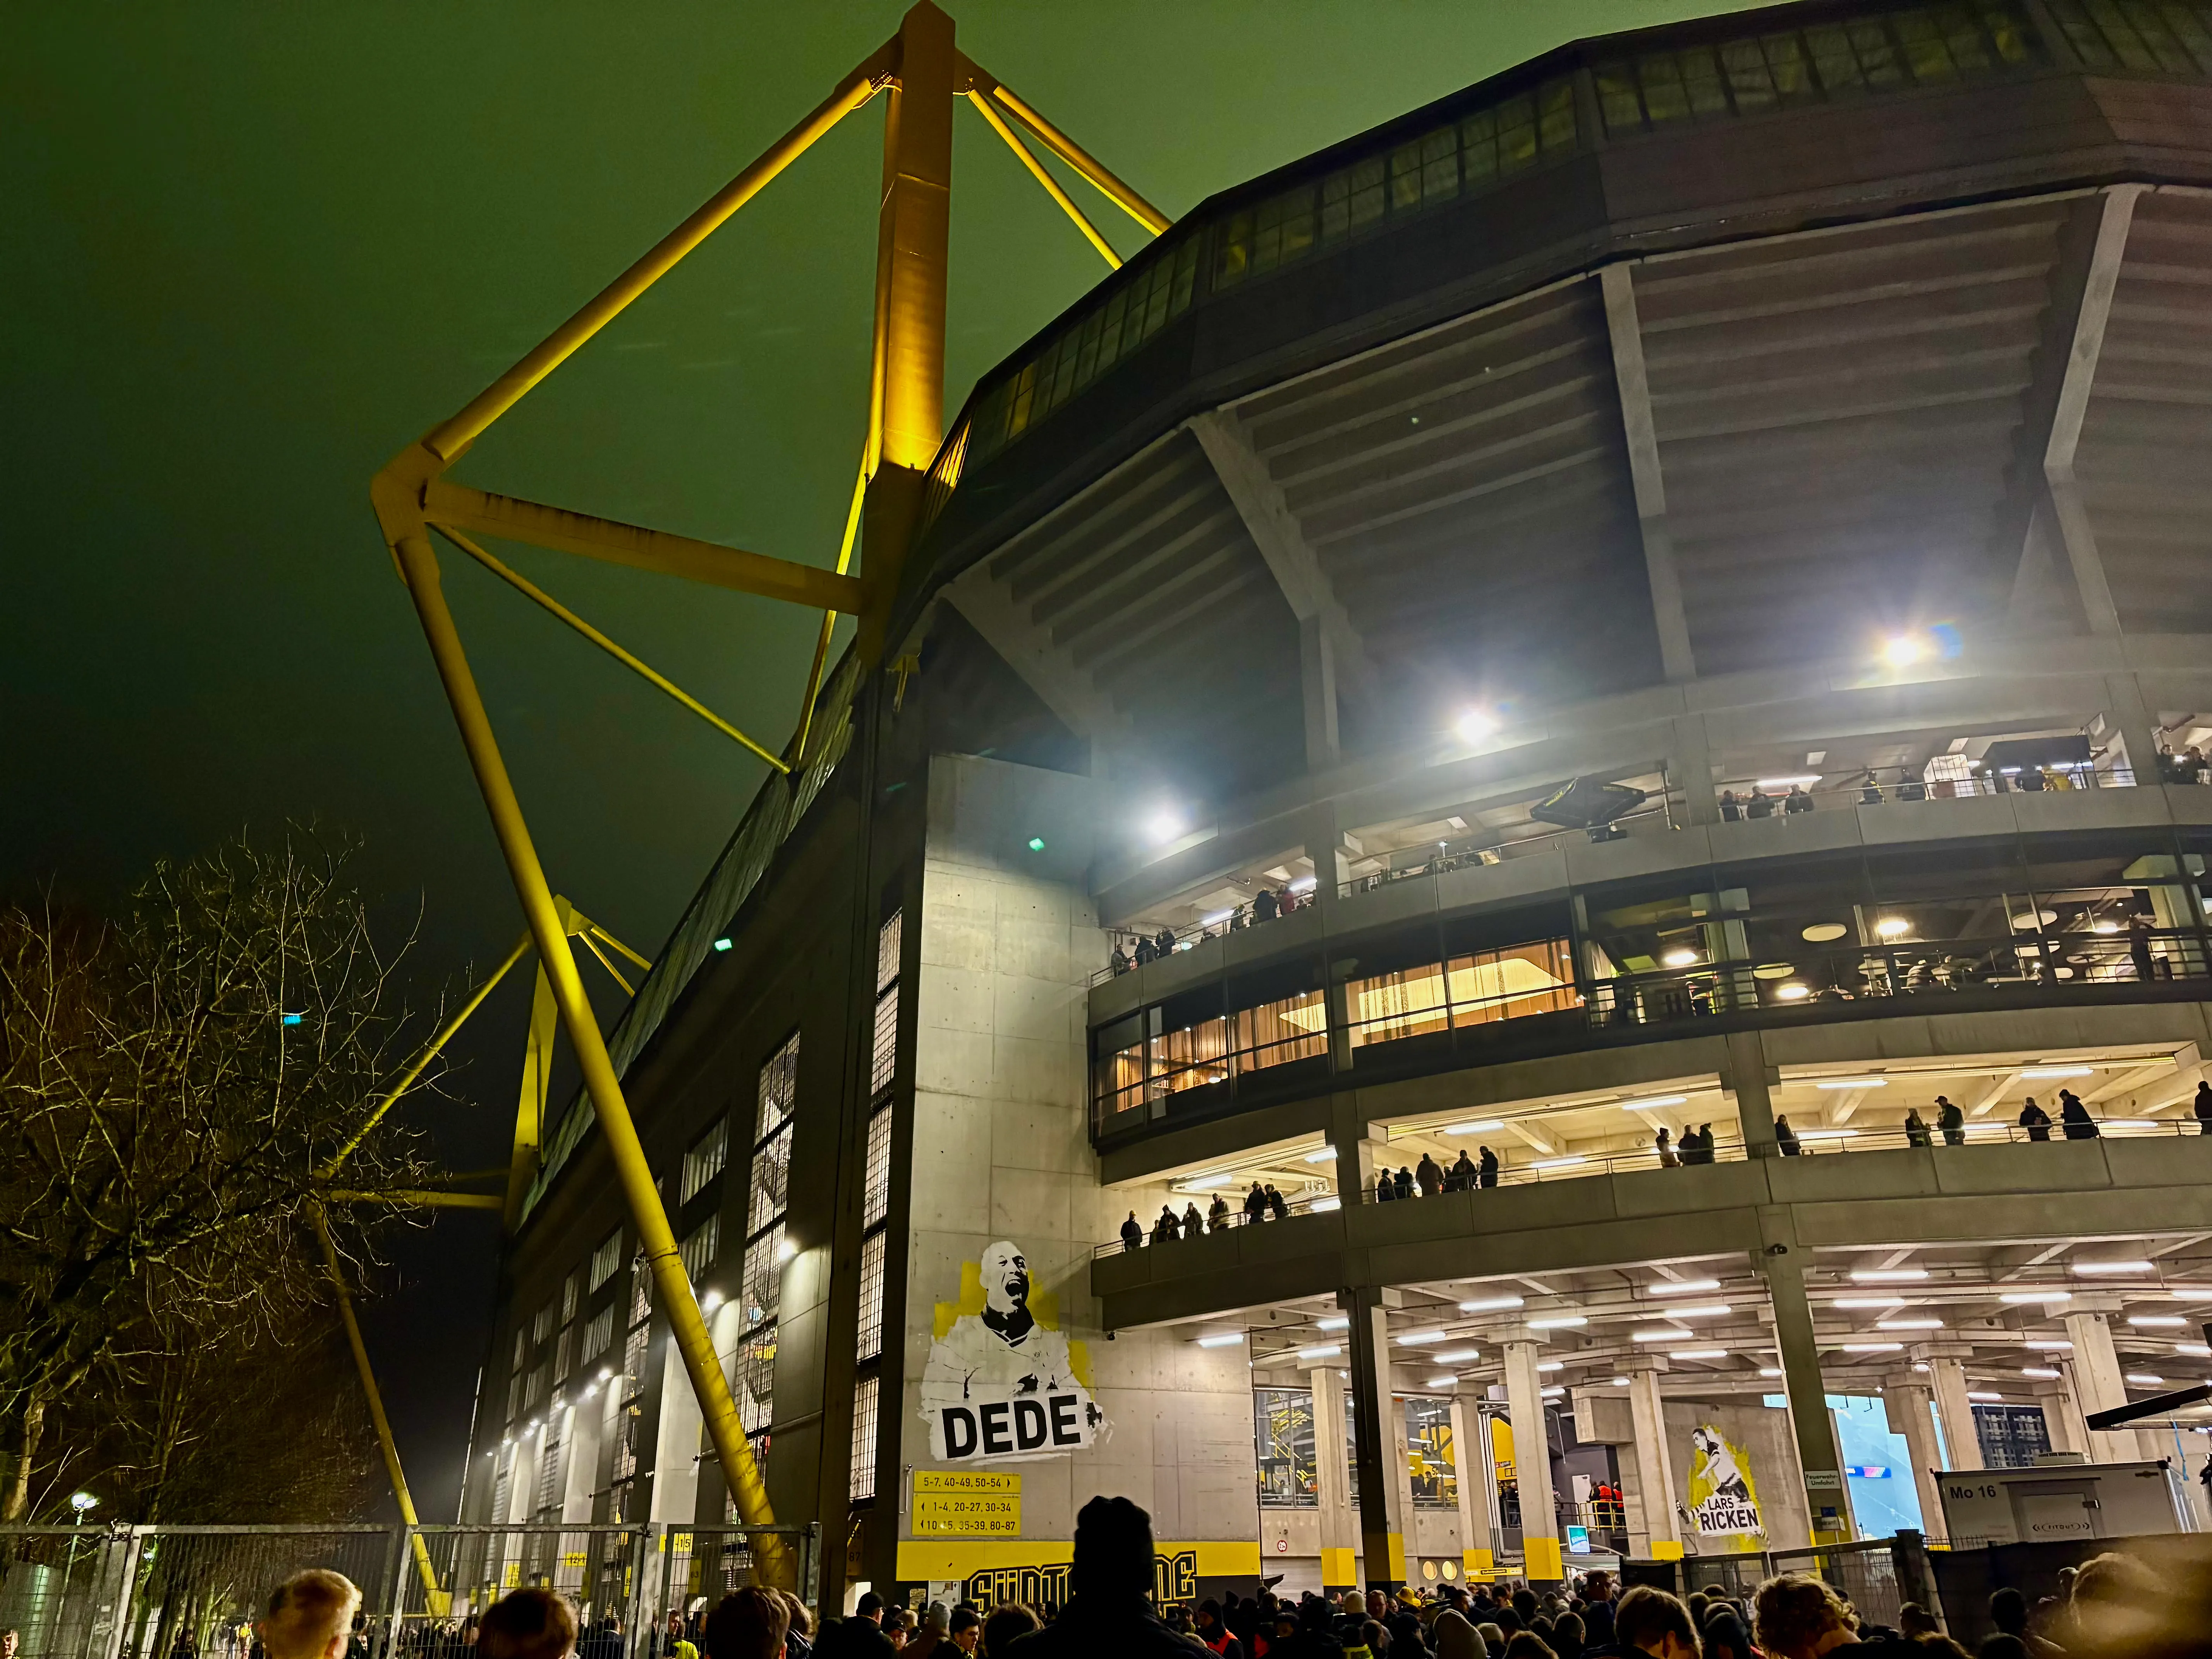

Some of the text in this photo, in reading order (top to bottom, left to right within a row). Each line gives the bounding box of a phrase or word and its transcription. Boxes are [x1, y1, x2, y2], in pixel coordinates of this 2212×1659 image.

[942, 1395, 1081, 1458] DEDE
[975, 1478, 1001, 1487] 50-54
[1949, 1485, 1996, 1498] Mo 16
[986, 1503, 1011, 1512] 30-34
[1707, 1498, 1734, 1510] LARS
[1700, 1508, 1759, 1530] RICKEN
[990, 1521, 1015, 1530] 80-87
[849, 1552, 860, 1561] 87
